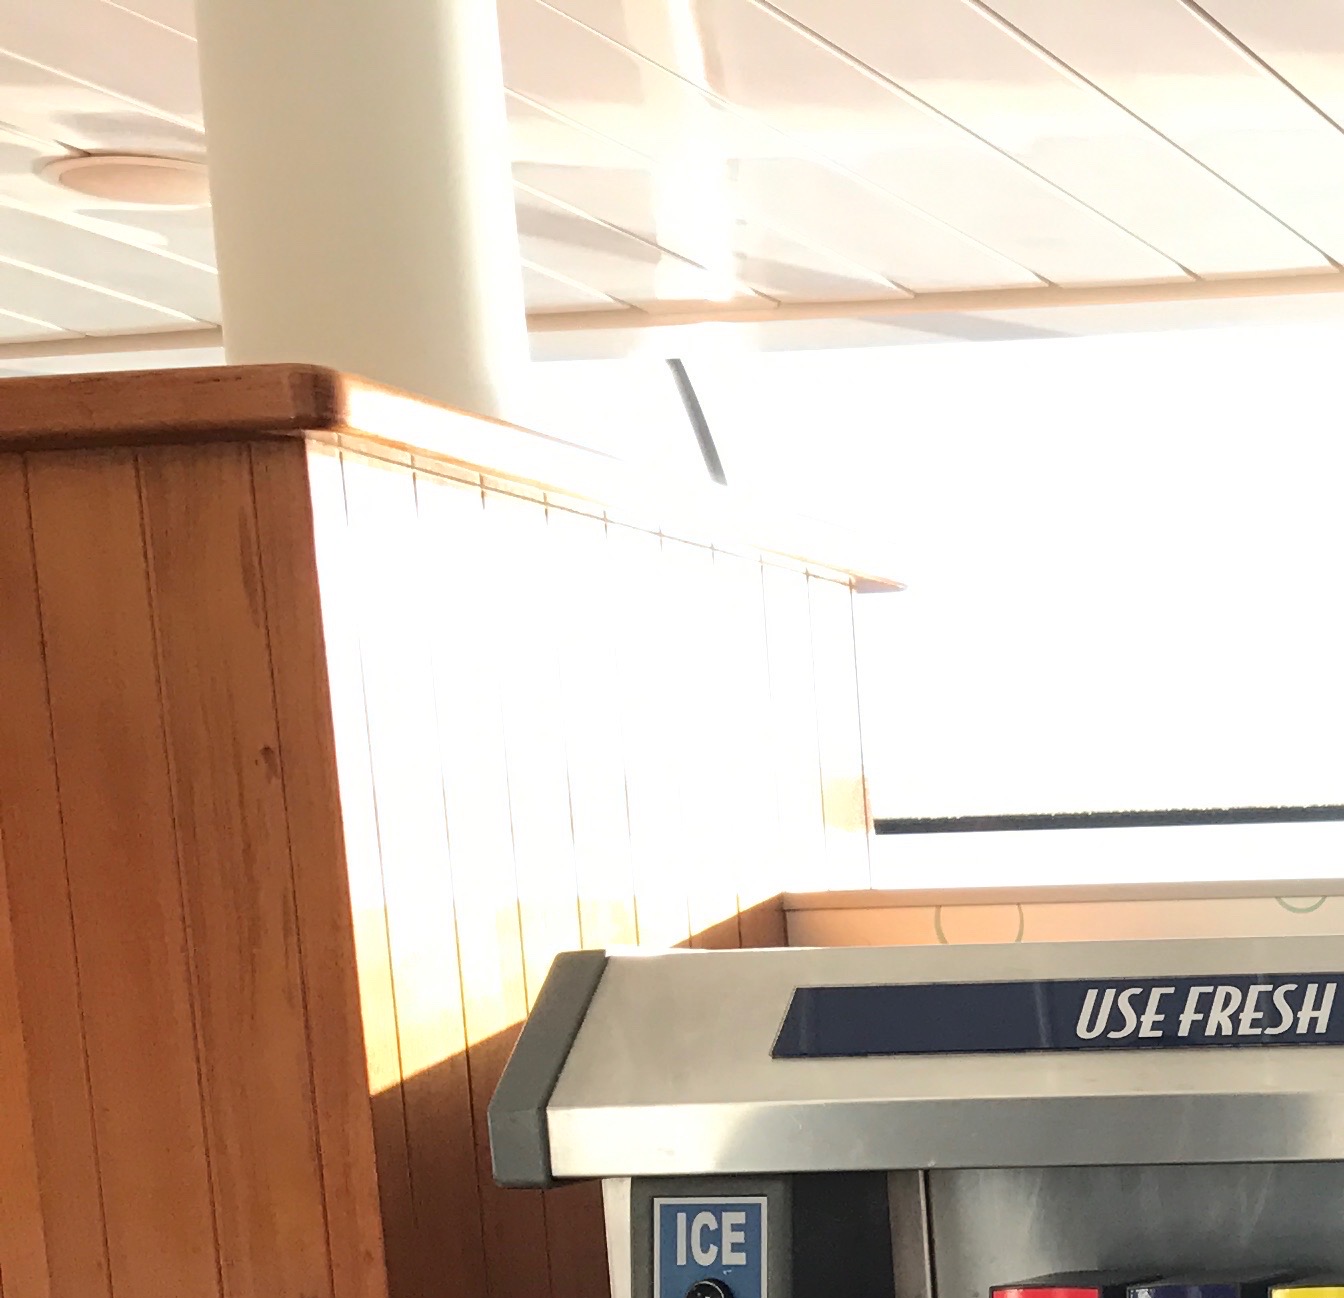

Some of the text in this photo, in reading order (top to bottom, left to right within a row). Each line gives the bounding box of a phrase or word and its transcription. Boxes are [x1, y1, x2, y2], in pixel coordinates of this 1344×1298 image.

[1075, 986, 1175, 1039] USE
[1177, 982, 1338, 1037] FRESH
[676, 1211, 747, 1266] ICE
